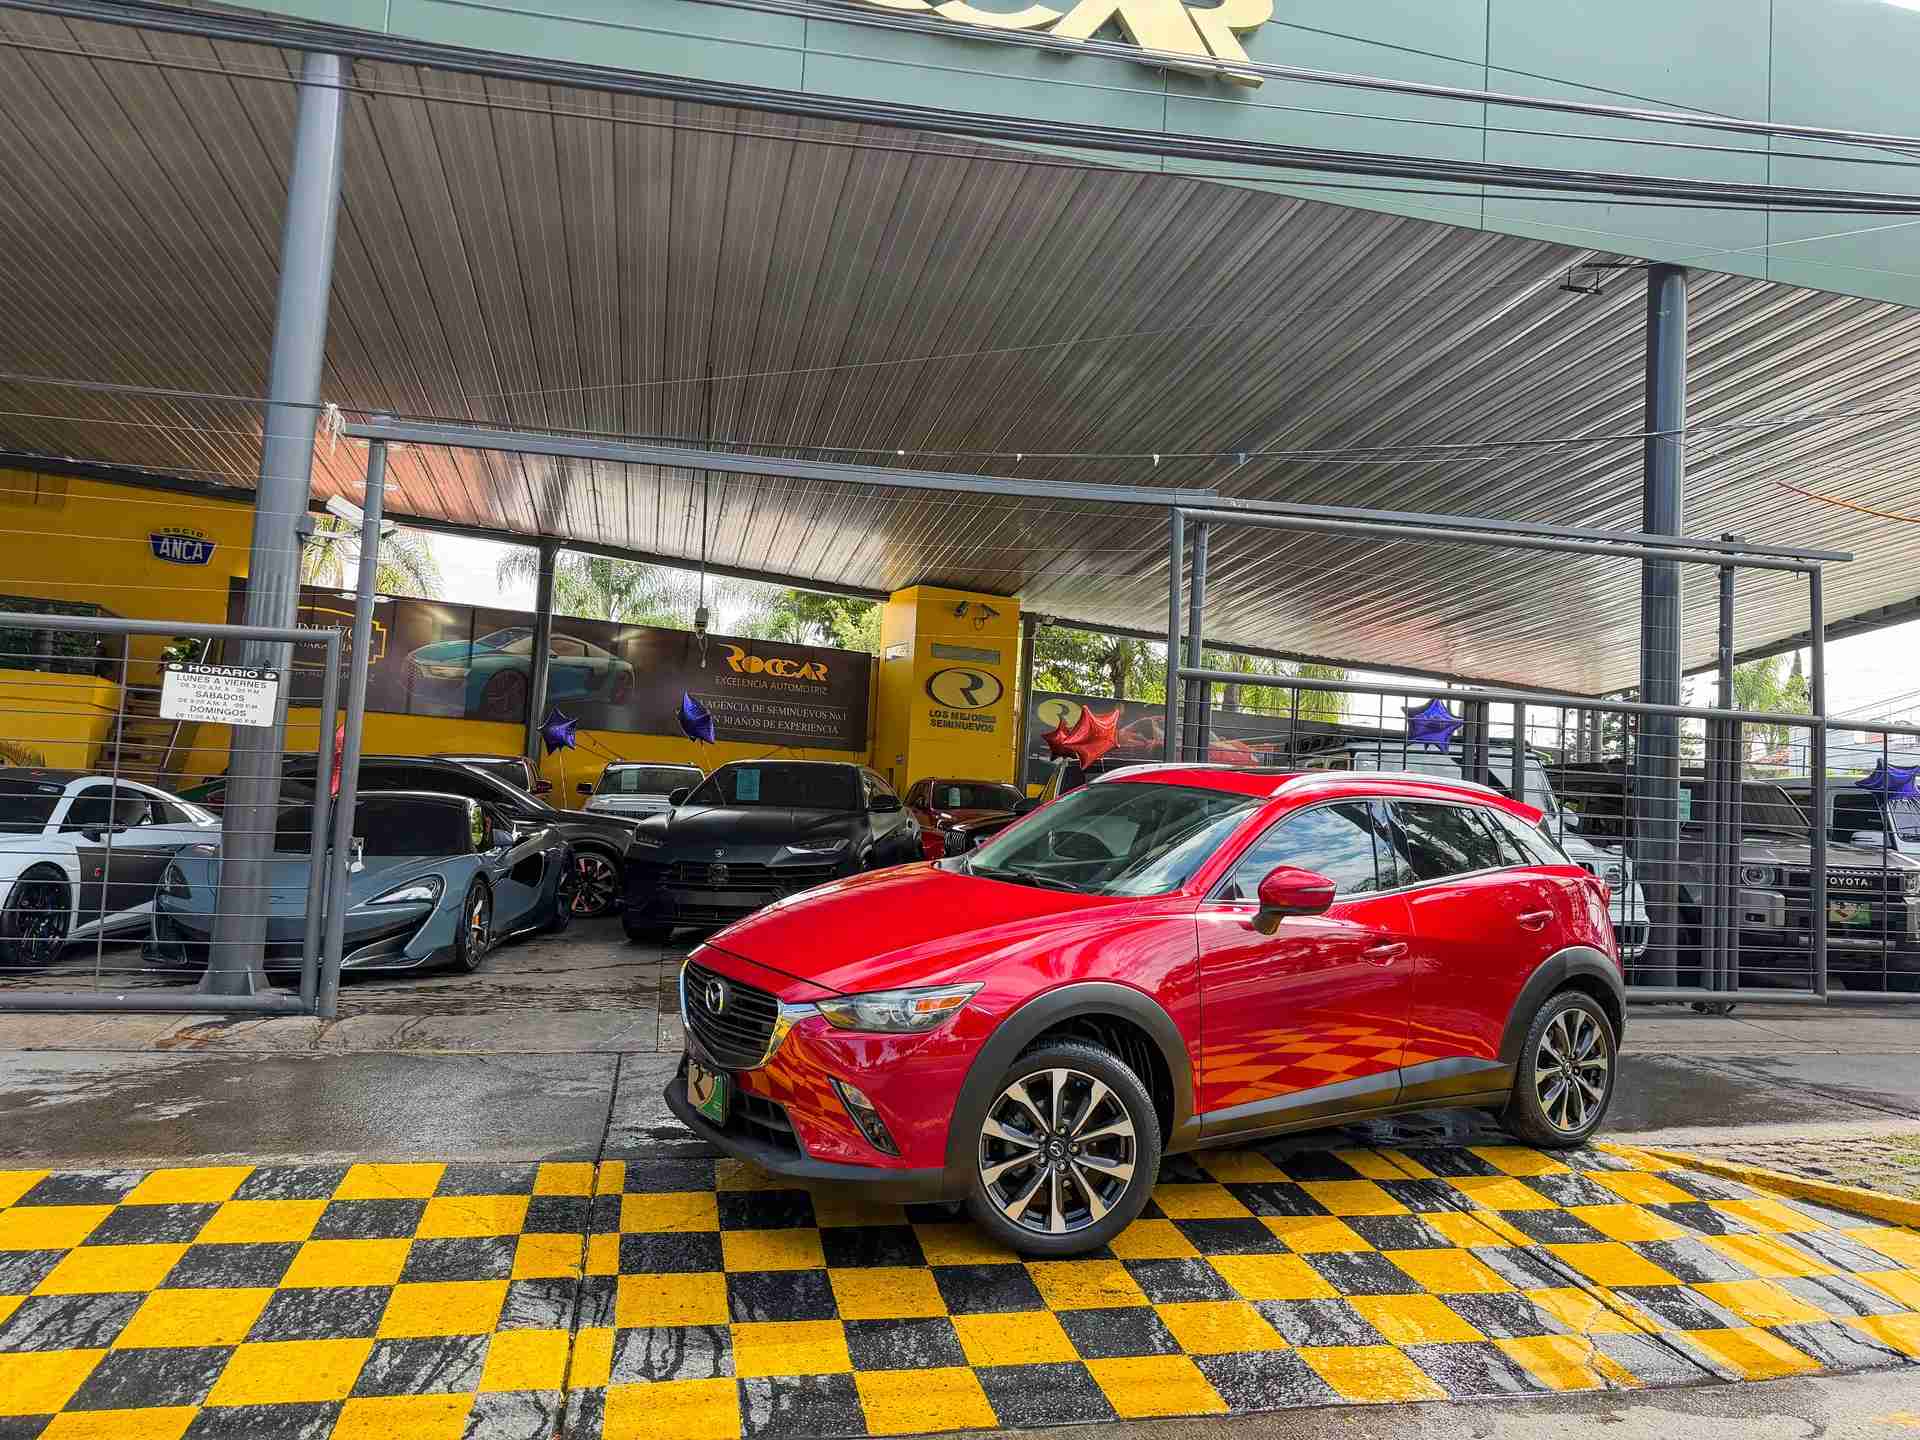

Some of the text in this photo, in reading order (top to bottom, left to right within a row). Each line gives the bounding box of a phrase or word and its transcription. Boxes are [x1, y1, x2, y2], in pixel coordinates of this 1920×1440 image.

[159, 538, 203, 560] ANCA
[718, 642, 830, 681] ROCCAR
[188, 665, 258, 679] HORARIO
[176, 674, 210, 684] LUNES
[224, 679, 267, 689] VIERNES
[190, 705, 247, 717] DOMINGOS
[929, 709, 950, 719] LOS
[930, 719, 994, 733] SEMINUEVOS
